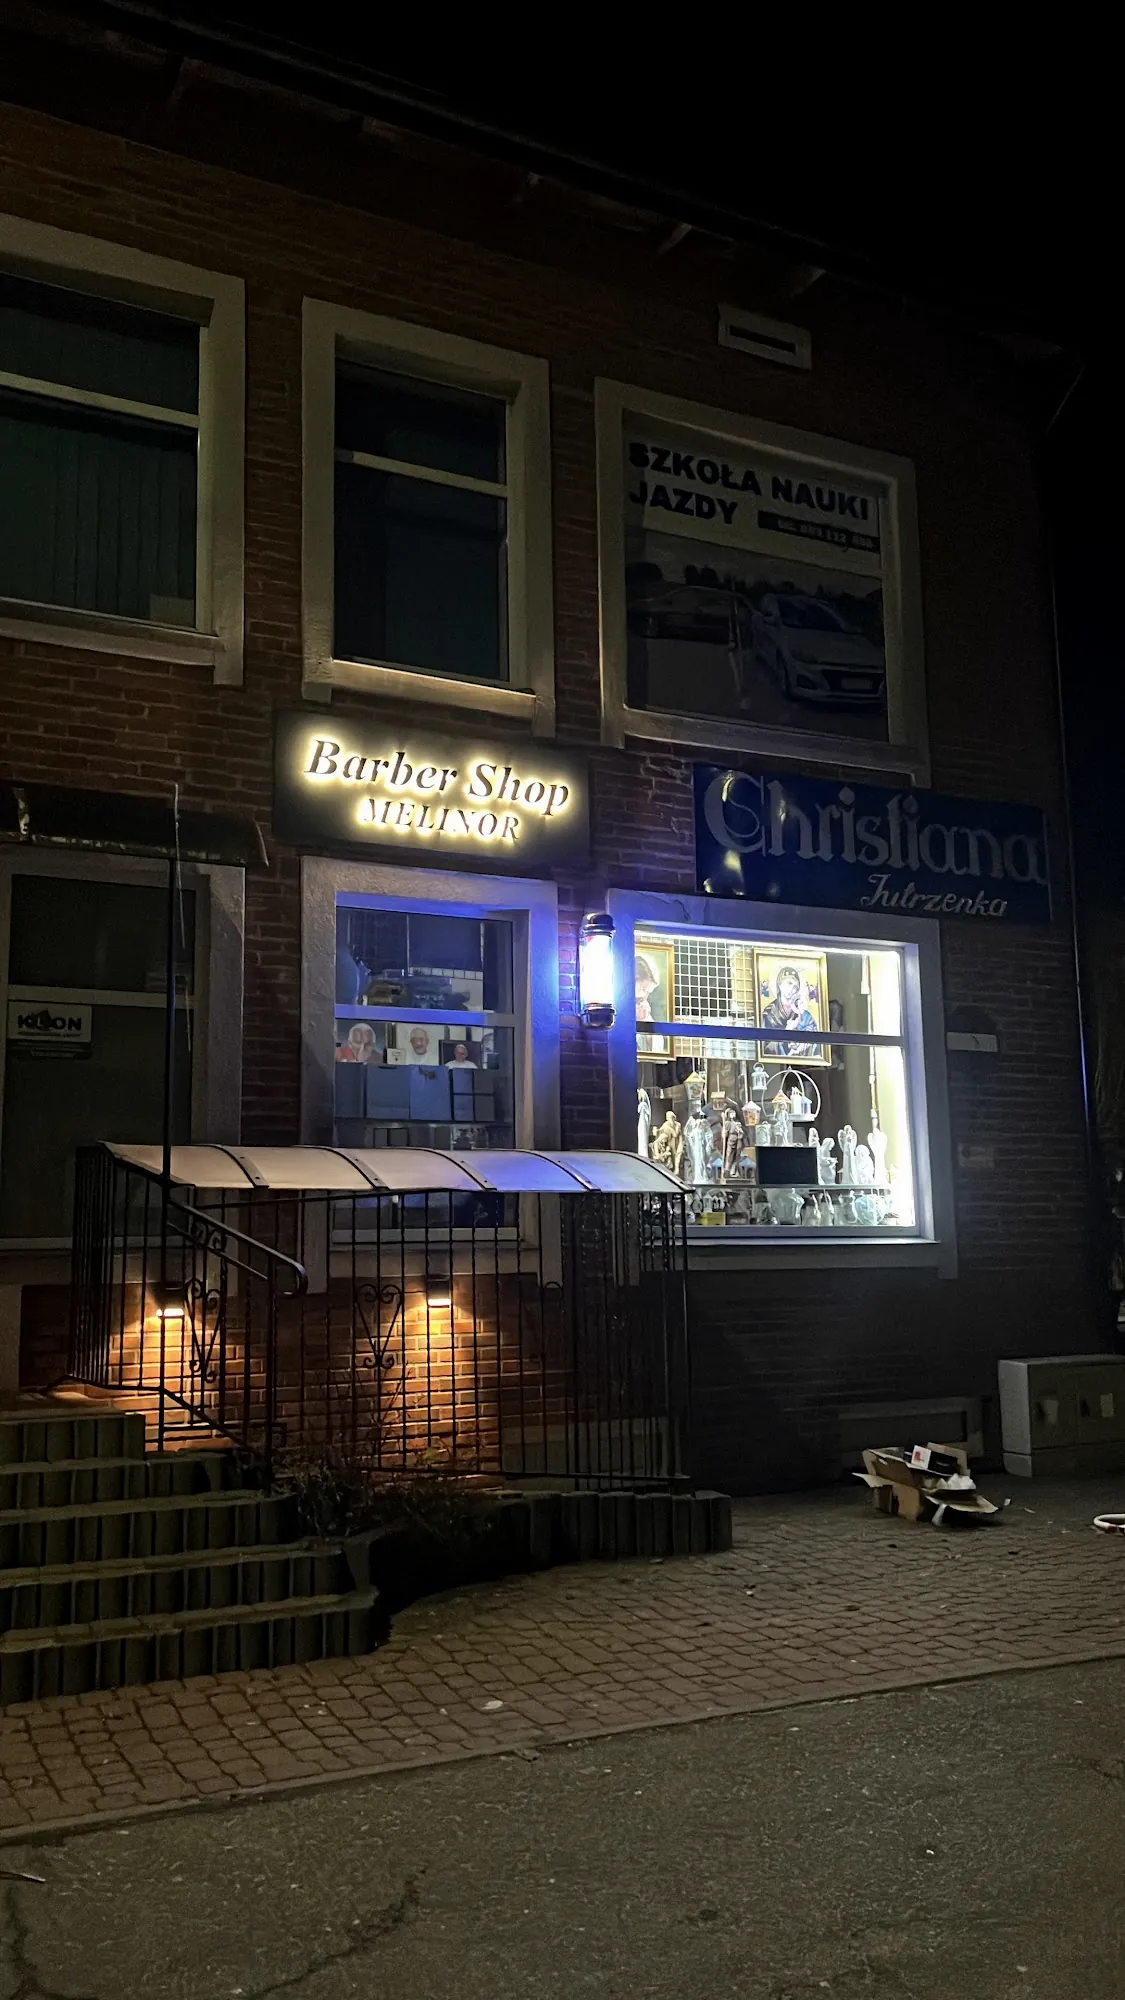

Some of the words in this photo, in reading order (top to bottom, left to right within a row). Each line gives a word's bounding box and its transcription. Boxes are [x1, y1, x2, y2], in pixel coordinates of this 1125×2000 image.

[629, 442, 762, 496] SZKOŁA
[772, 476, 868, 520] NAUKI
[629, 480, 738, 524] JAZDY
[304, 739, 458, 792] Barber
[469, 763, 570, 817] Shop
[363, 798, 520, 840] MELINOR
[703, 769, 1049, 886] Christiana
[861, 873, 1008, 917] Jutrzenka
